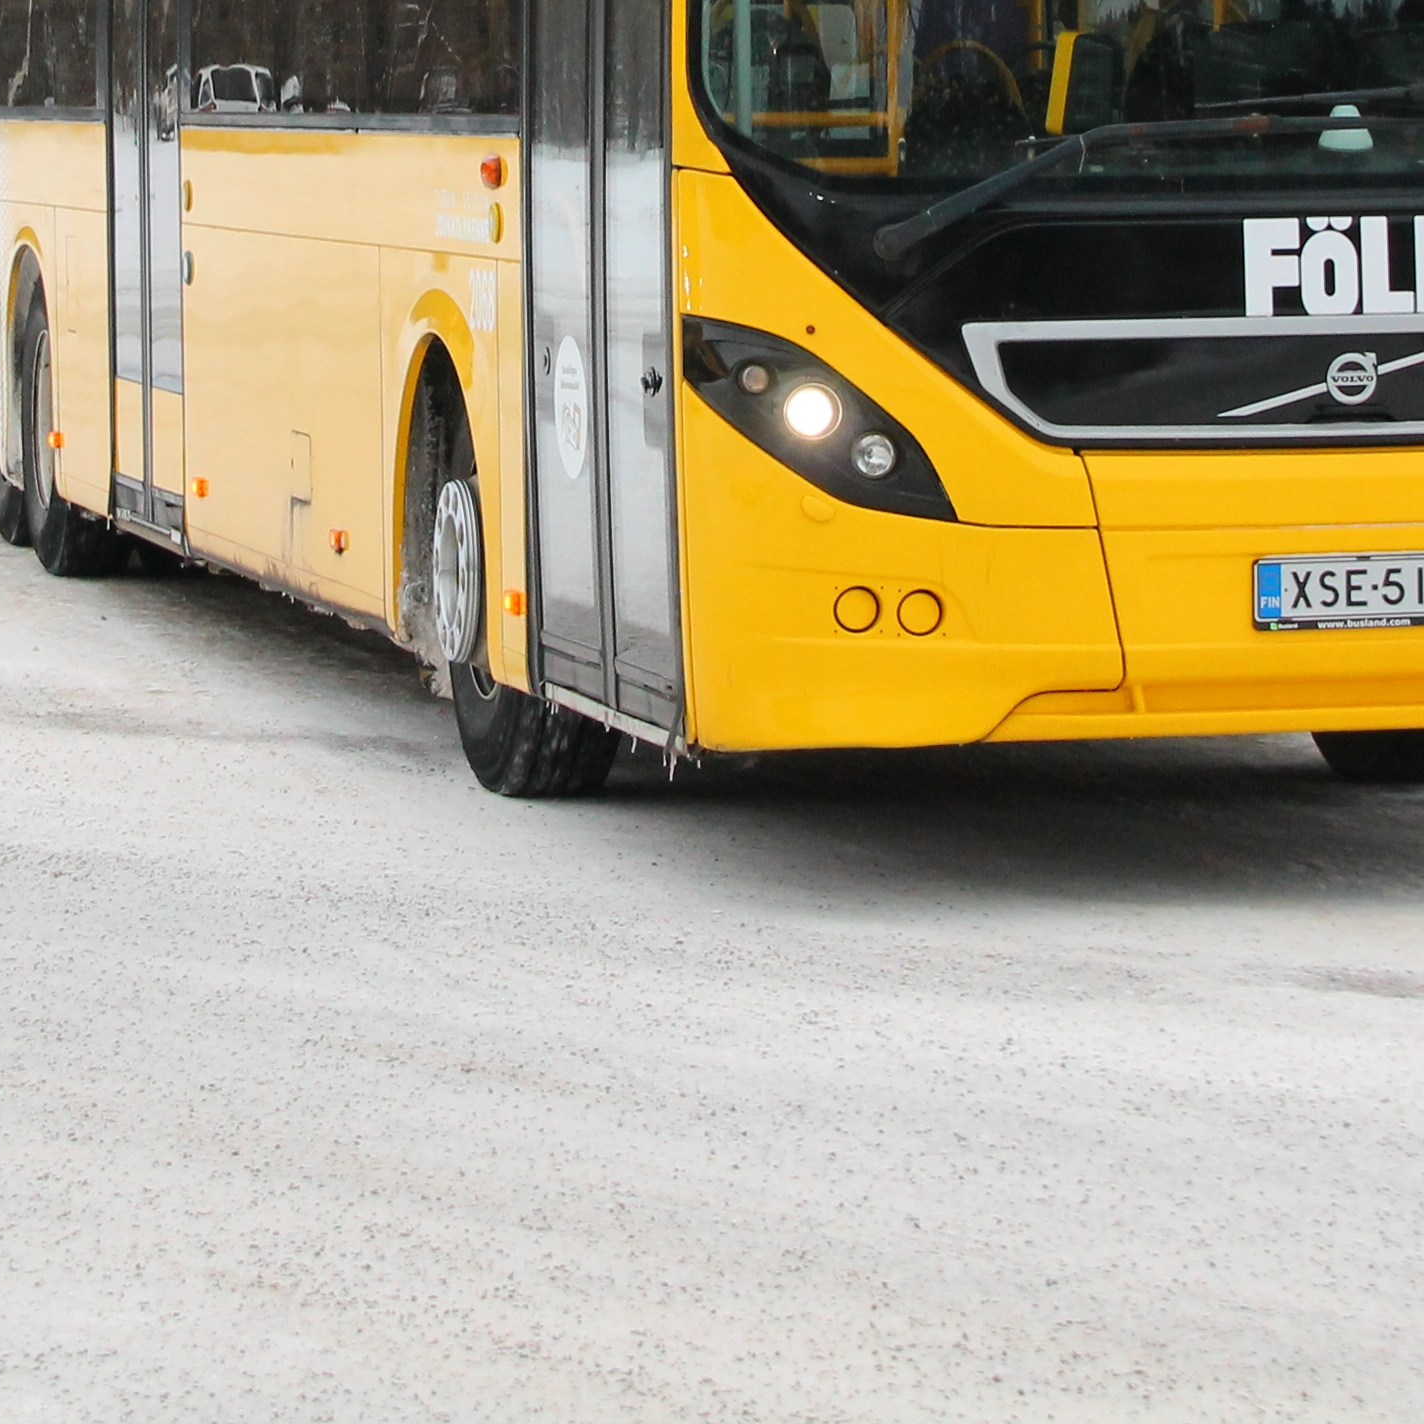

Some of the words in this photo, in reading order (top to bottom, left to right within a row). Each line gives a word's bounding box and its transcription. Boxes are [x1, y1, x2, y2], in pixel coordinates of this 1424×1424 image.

[469, 269, 496, 333] 2068
[1330, 375, 1374, 384] VOLVO
[1260, 595, 1280, 609] FIN
[1316, 617, 1411, 631] www.busland.com
